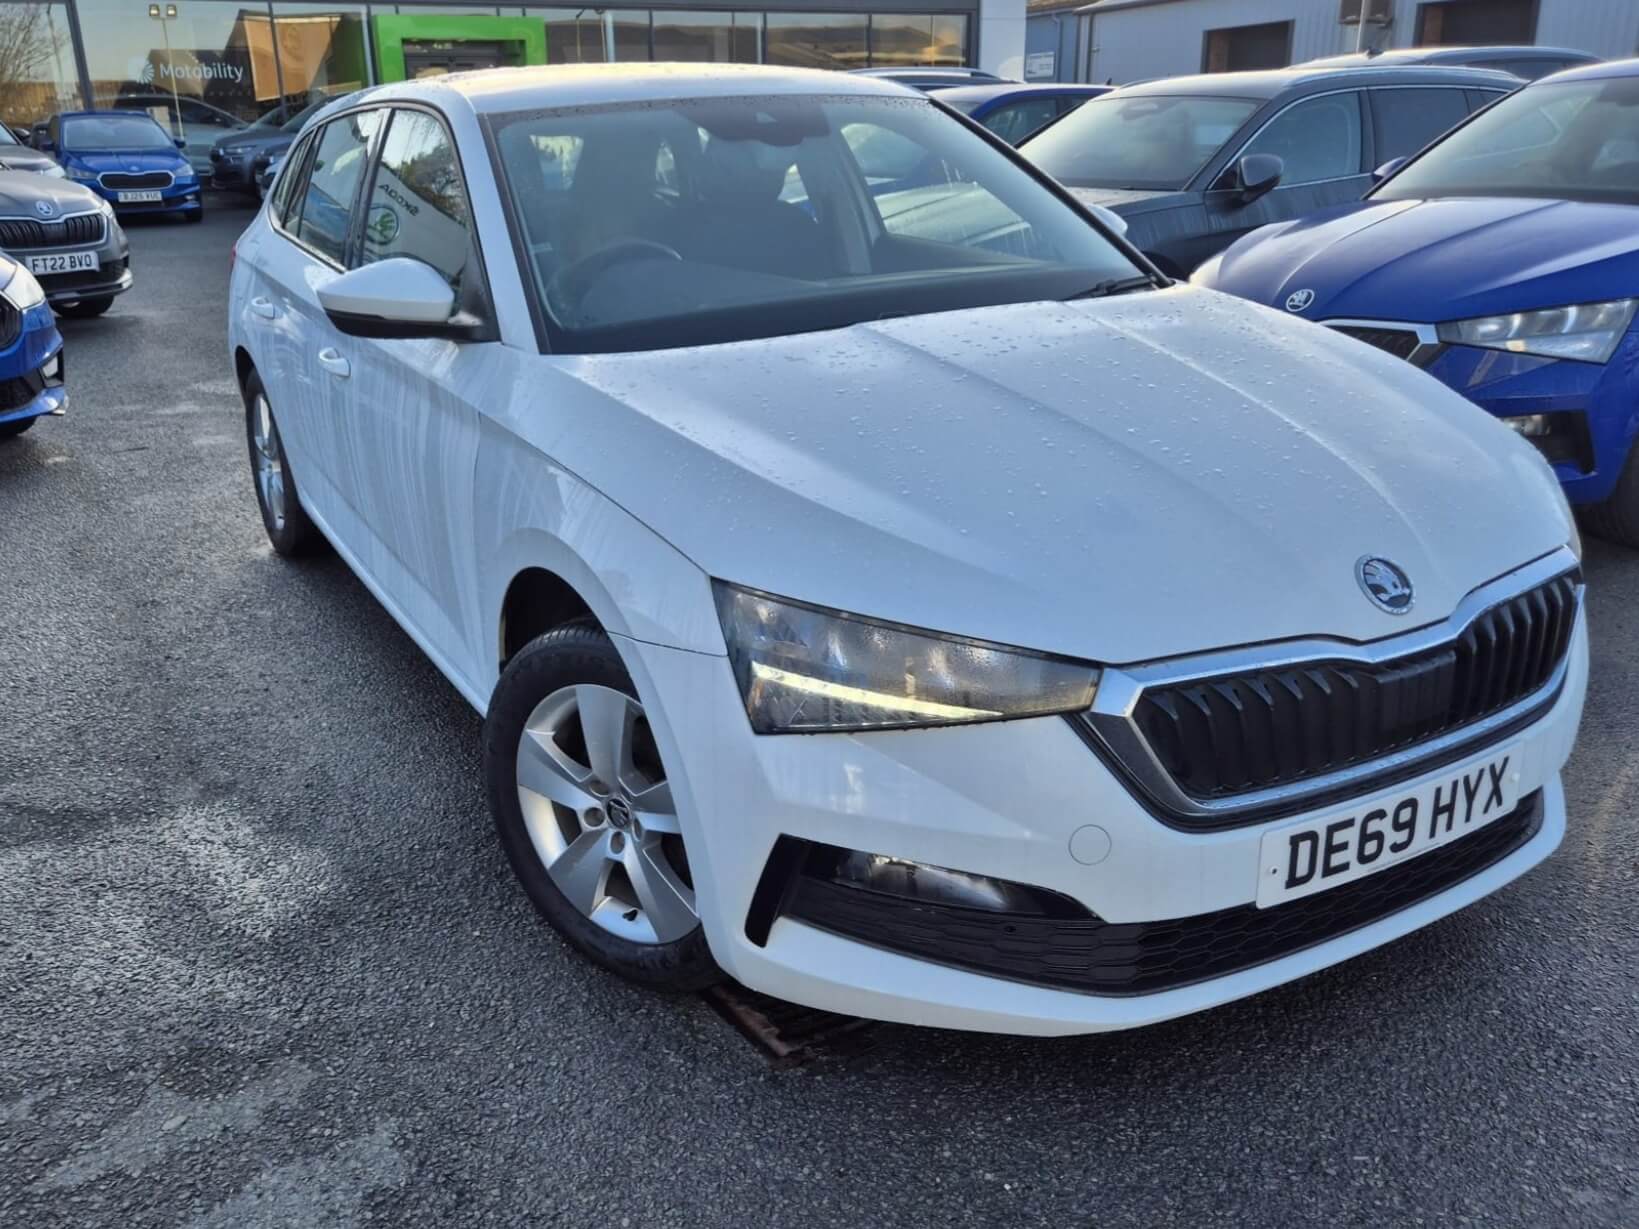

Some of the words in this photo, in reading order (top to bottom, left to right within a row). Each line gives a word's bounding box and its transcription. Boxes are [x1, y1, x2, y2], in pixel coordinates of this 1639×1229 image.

[160, 63, 244, 84] Motobility
[32, 256, 67, 273] FT22
[1285, 797, 1419, 890] DE69
[1428, 756, 1510, 840] HYX
